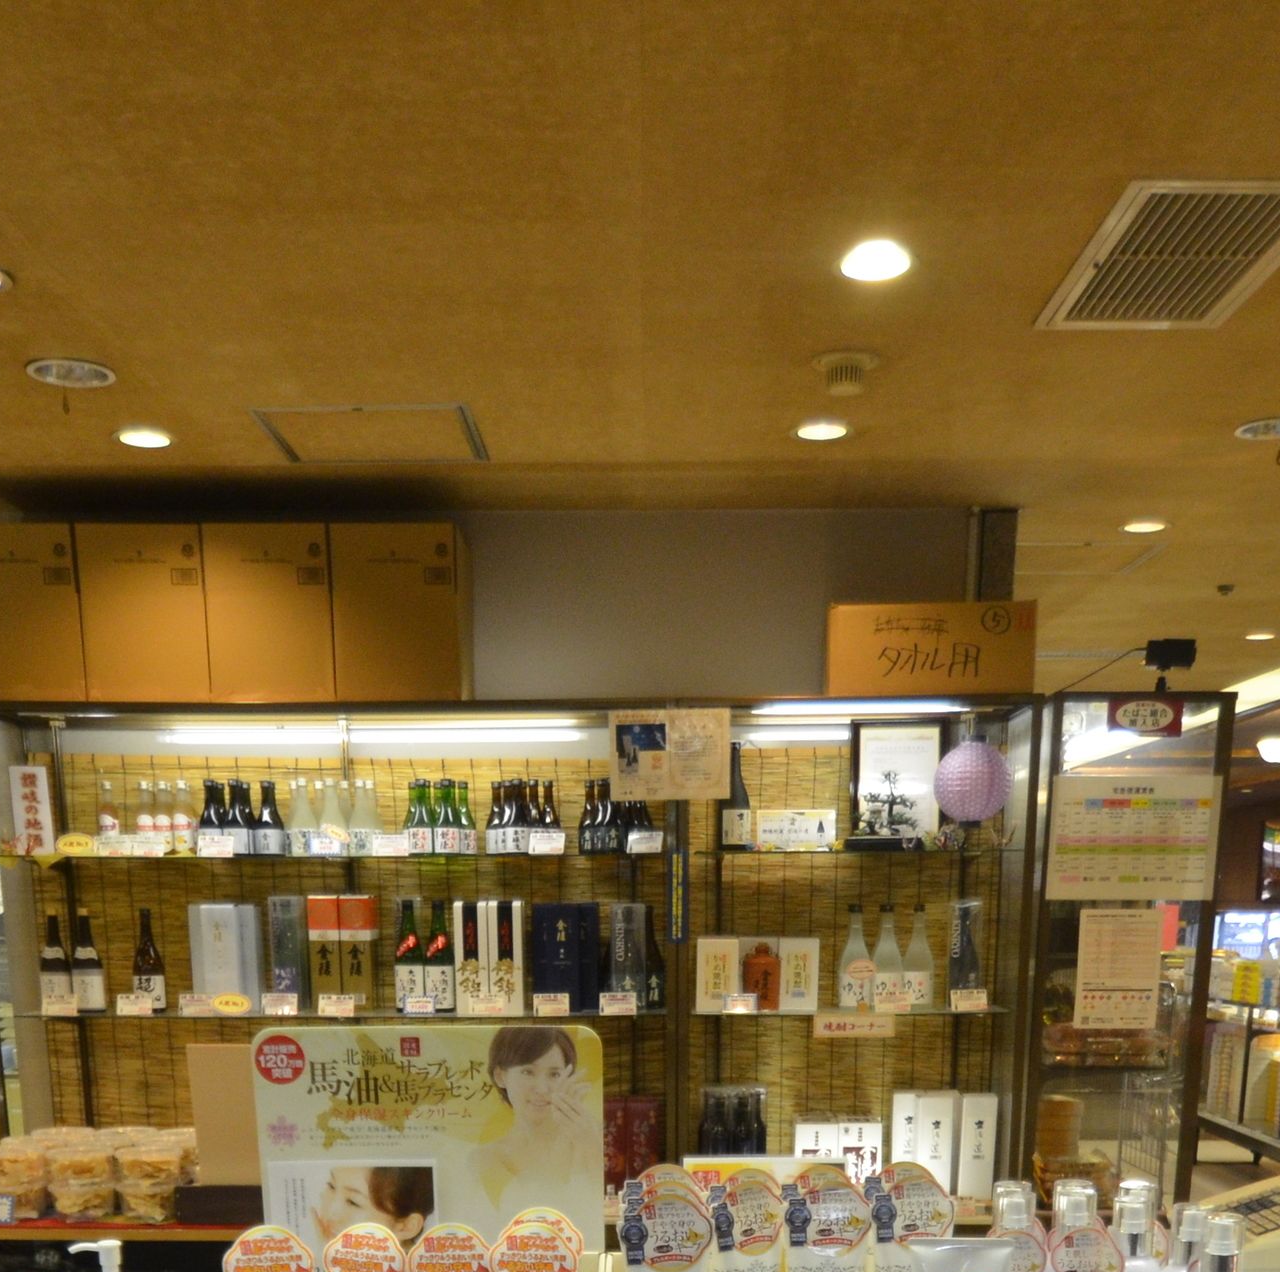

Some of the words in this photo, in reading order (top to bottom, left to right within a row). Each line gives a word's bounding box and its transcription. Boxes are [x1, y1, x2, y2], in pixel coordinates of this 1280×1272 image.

[878, 642, 980, 678] タオル用
[823, 1022, 886, 1032] 焼酎コーナー
[343, 1047, 396, 1067] 北海道
[397, 1058, 484, 1081] サラブレッド
